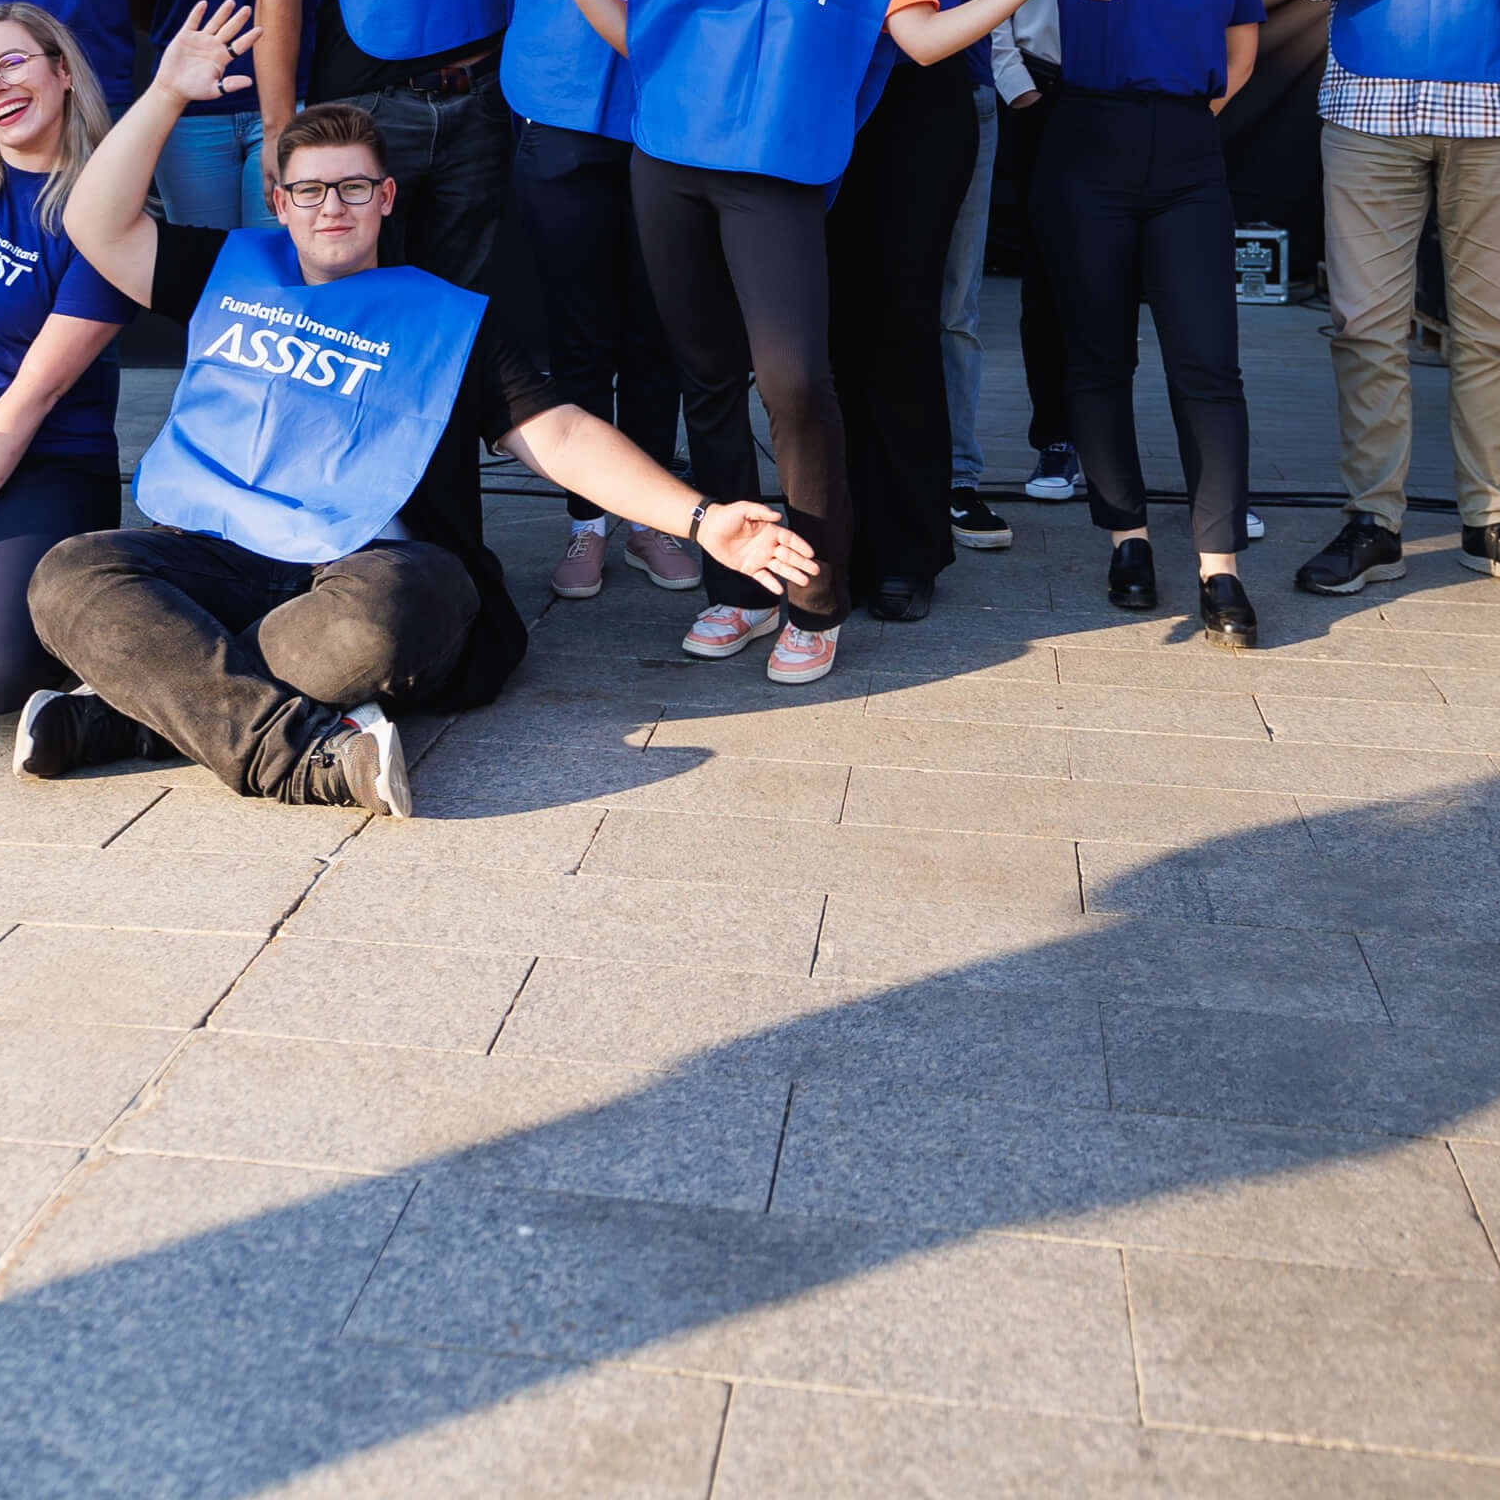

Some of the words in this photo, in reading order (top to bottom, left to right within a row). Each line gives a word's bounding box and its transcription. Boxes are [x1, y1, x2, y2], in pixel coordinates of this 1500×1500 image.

[203, 322, 382, 395] ASSIST
[220, 295, 294, 326] Fundația
[294, 313, 391, 357] Umanitară
